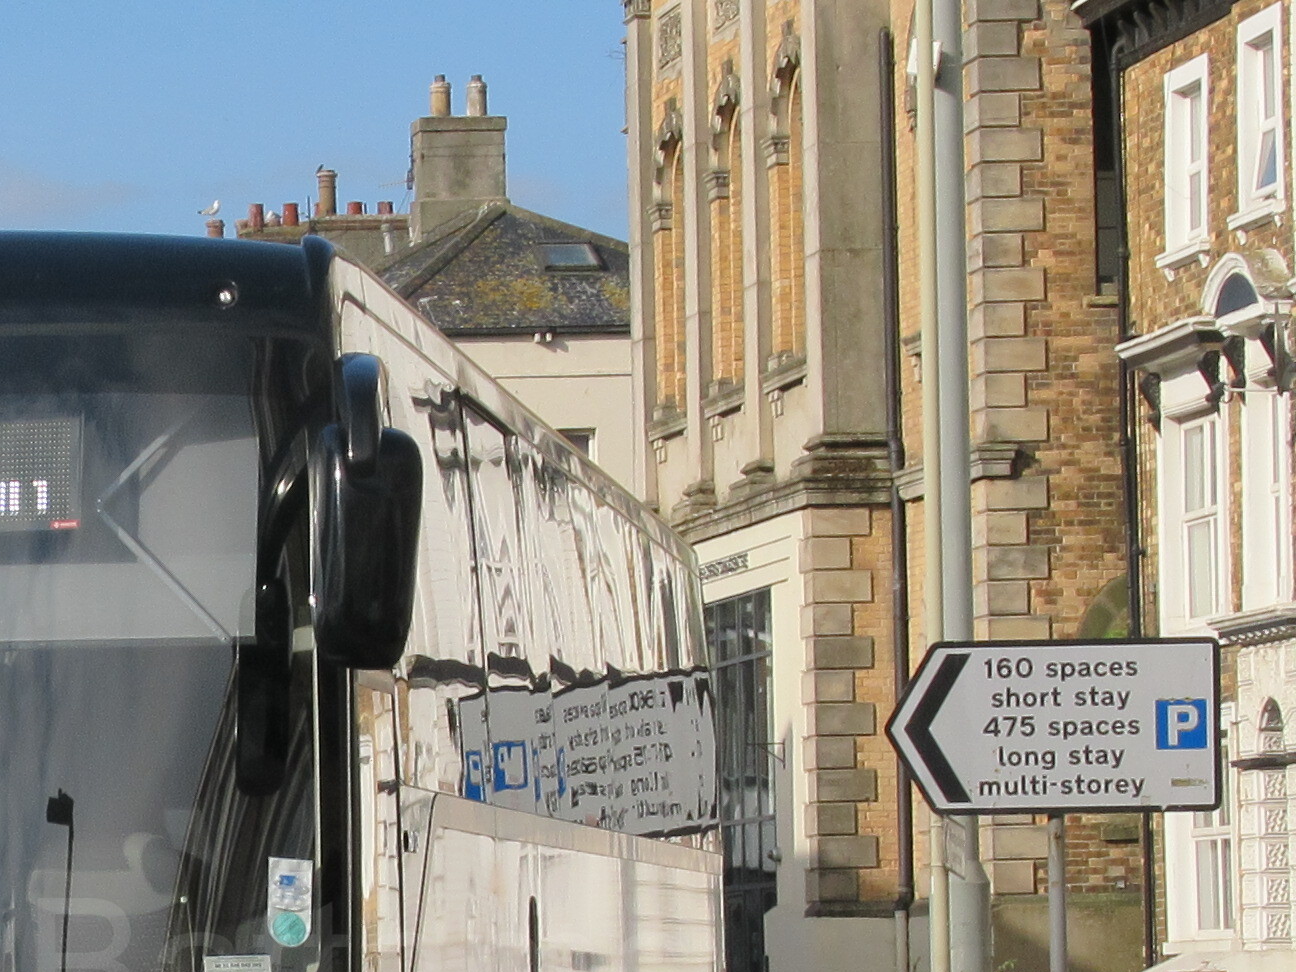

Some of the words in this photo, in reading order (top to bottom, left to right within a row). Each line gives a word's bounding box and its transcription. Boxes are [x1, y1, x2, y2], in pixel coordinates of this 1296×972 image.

[984, 657, 1033, 679] 160
[1046, 659, 1138, 682] spaces
[991, 687, 1061, 708] short
[1075, 687, 1131, 710] stay
[982, 715, 1035, 737] 475
[1048, 717, 1141, 740] spaces
[1167, 705, 1199, 746] P
[998, 746, 1056, 769] long
[1068, 745, 1124, 768] stay
[978, 774, 1145, 797] multi-storey
